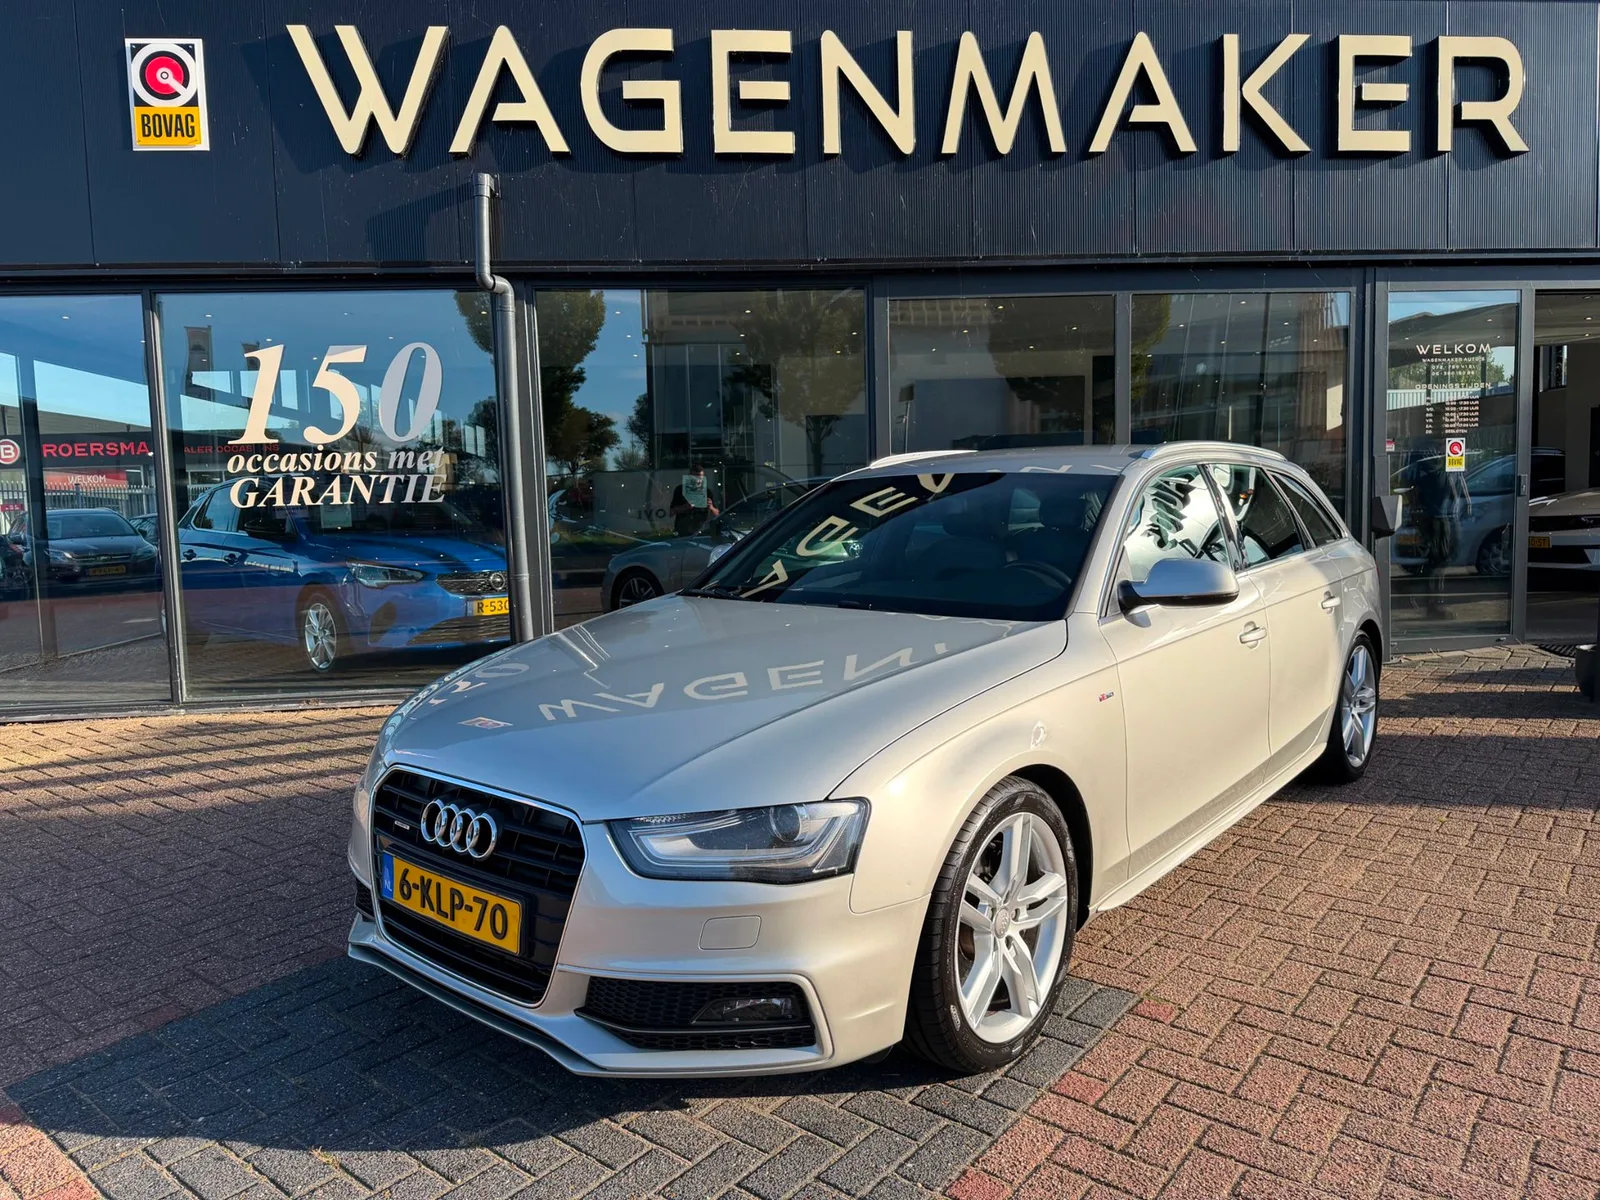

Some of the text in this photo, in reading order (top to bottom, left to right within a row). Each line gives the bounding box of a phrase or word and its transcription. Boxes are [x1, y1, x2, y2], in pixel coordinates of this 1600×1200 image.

[286, 24, 1530, 155] WAGENMAKER
[141, 114, 195, 138] BOVAG
[1416, 343, 1491, 355] WELKOM
[228, 342, 443, 444] 150
[42, 441, 149, 458] ROERSMA
[227, 445, 445, 474] occasions met
[68, 475, 107, 484] WELKOM
[230, 473, 447, 509] GARANTIE
[399, 868, 508, 941] 6-KLP-70
